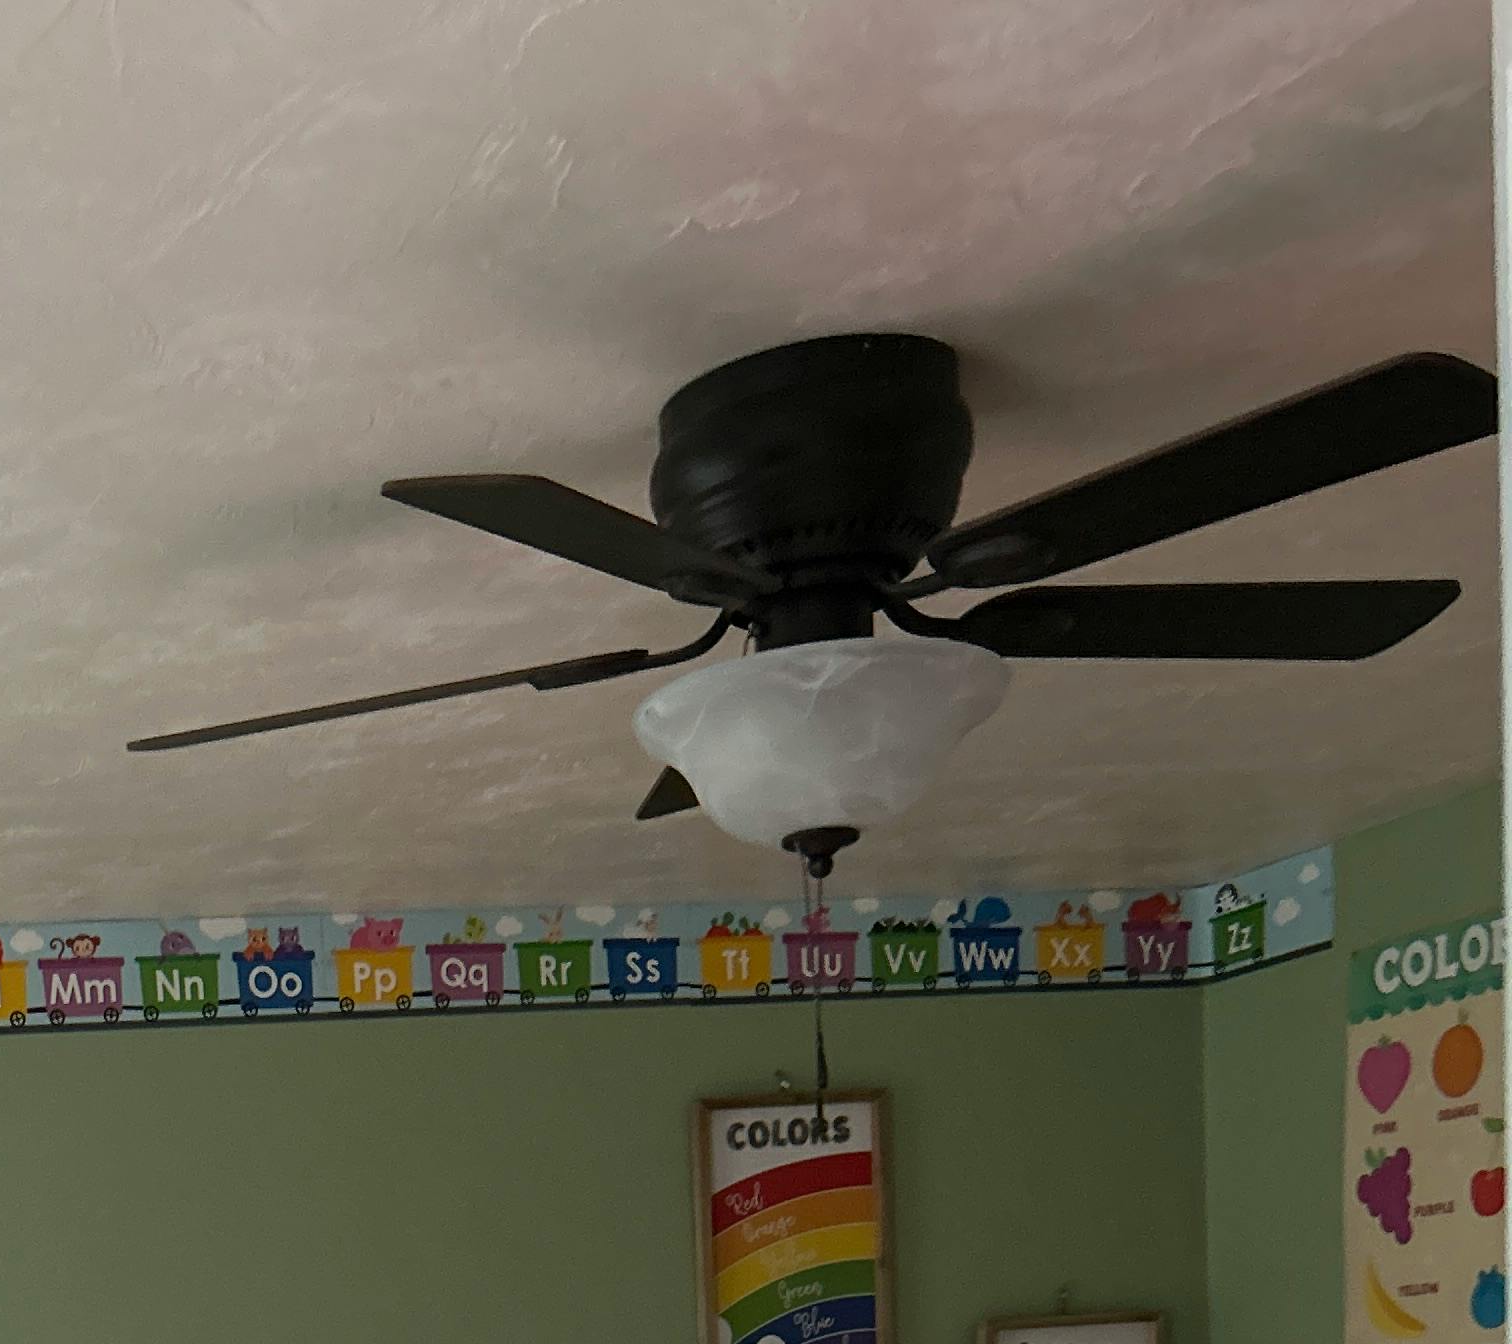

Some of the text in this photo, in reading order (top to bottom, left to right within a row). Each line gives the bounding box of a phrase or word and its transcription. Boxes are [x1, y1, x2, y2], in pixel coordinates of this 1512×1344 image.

[1049, 937, 1091, 968] Xx
[1136, 934, 1174, 970] Yy
[1226, 922, 1252, 954] Zz
[540, 956, 572, 987] Rr
[625, 952, 661, 985] Ss
[722, 948, 751, 981] Tt
[800, 945, 842, 978] Uu
[884, 943, 926, 974] Vv
[958, 940, 1016, 971] Ww
[49, 974, 118, 1008] Mm
[156, 970, 205, 1003] Nn
[248, 966, 303, 998] Oo
[354, 961, 398, 1001] Pp
[440, 957, 489, 998] Qq
[727, 1115, 851, 1151] COLORS
[726, 1182, 764, 1216] Red
[778, 1280, 823, 1308] Green
[793, 1306, 836, 1338] Blue
